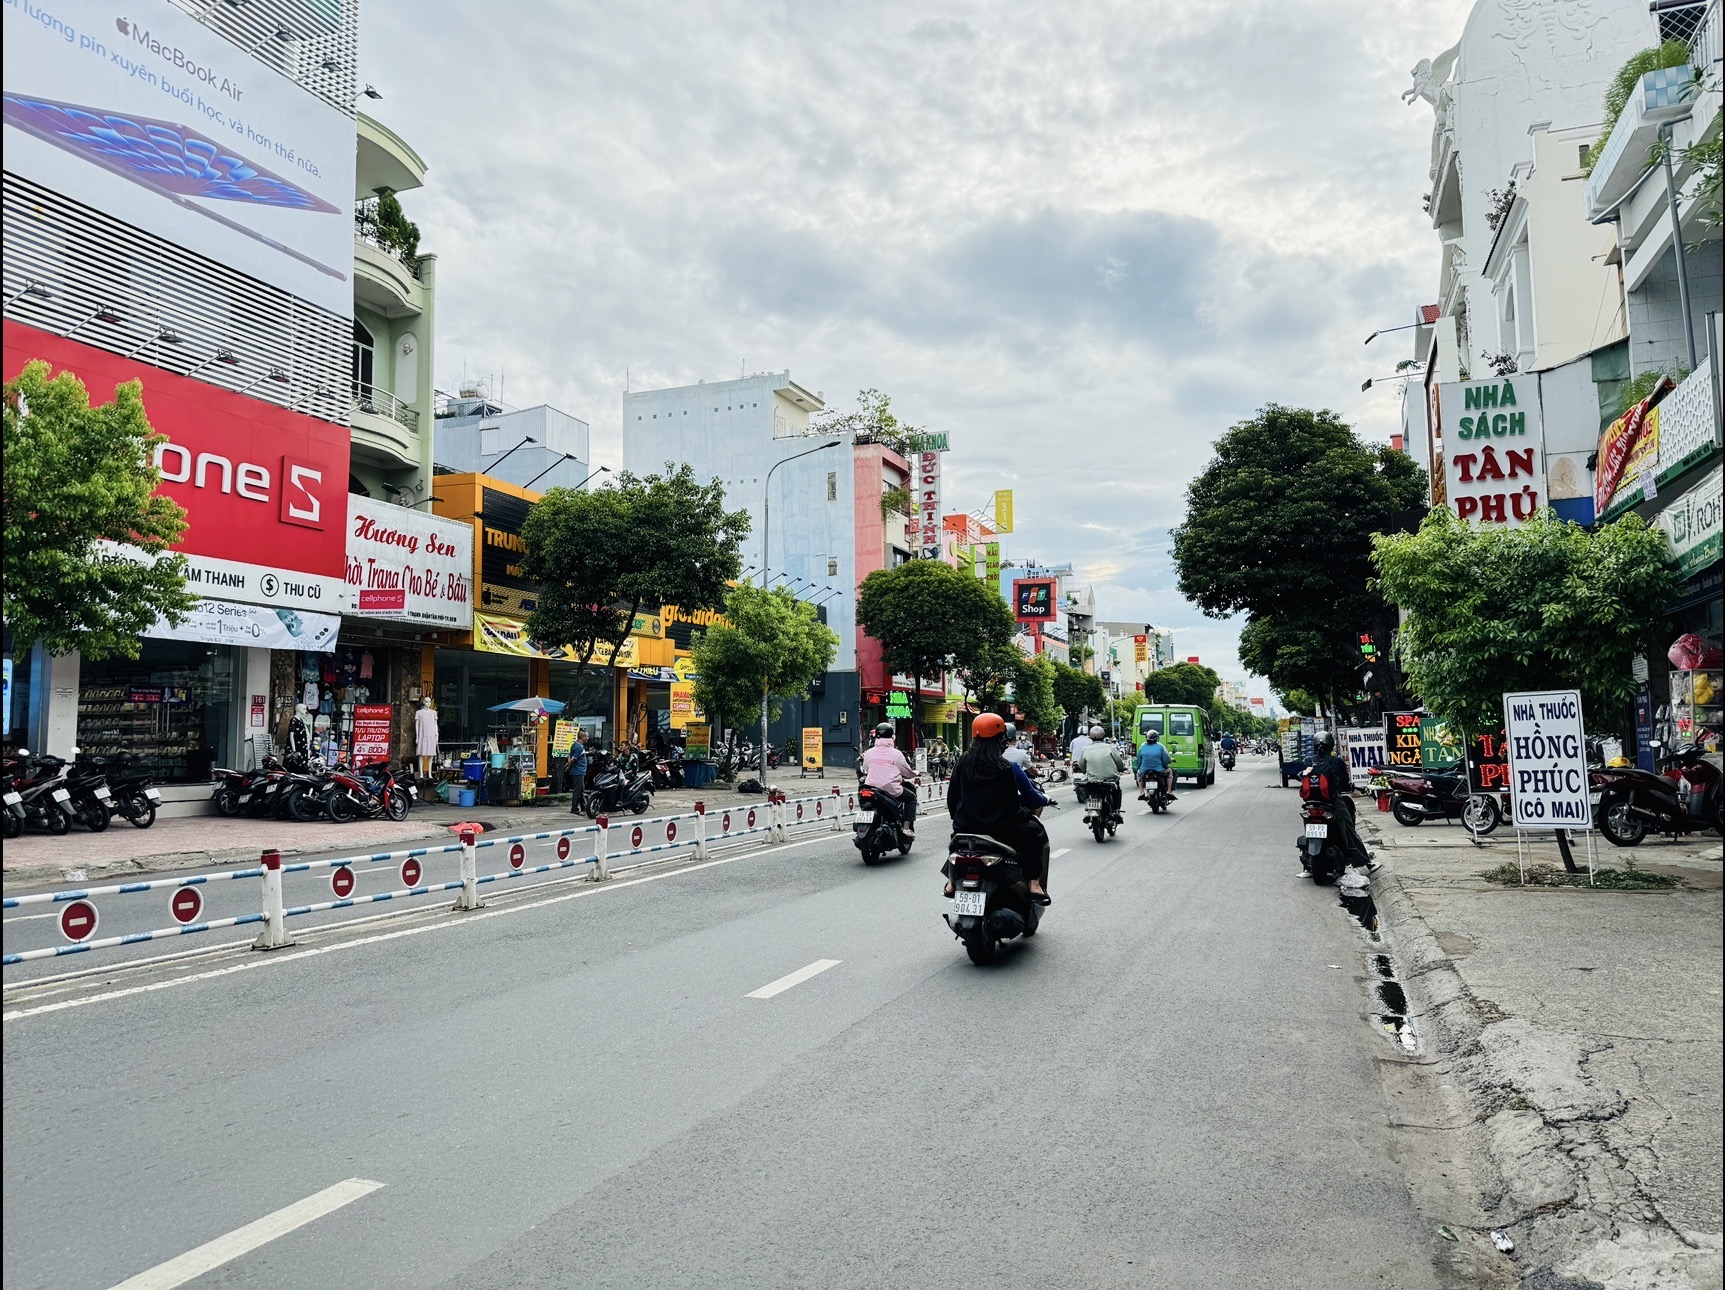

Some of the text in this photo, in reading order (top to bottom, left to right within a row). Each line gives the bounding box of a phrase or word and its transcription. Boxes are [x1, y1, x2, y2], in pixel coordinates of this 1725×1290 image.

[132, 24, 243, 102] MacBook Air
[80, 33, 106, 57] pin
[110, 51, 157, 86] xuyên
[161, 77, 194, 105] buổi
[197, 97, 226, 126] học,
[229, 117, 244, 134] và
[248, 126, 272, 151] hơn
[275, 141, 294, 163] thế
[297, 158, 321, 178] nữa.
[1464, 379, 1517, 410] NHÀ
[1458, 411, 1525, 440] SÁCH
[1453, 445, 1534, 483] TÂN
[922, 452, 936, 544] ĐỨC THỊNH
[1455, 485, 1538, 523] PHÚ
[354, 514, 457, 558] Hương Sen
[205, 570, 245, 588] THANH
[283, 582, 304, 597] THU
[307, 583, 321, 599] CŨ
[367, 557, 399, 589] Trang
[401, 564, 422, 600] Cho
[424, 567, 439, 599] Bé
[447, 571, 468, 603] Bầu
[217, 603, 247, 618] Series
[361, 595, 397, 603] cellphone
[1022, 604, 1045, 614] Shop
[1396, 715, 1421, 727] SPA
[1513, 696, 1576, 721] NHÀ THUỐC
[358, 734, 386, 742] LAPTOP
[1349, 730, 1384, 743] NHÀ THUỐC
[1514, 722, 1579, 760] HỒNG
[1350, 745, 1384, 768] MAI
[1390, 749, 1422, 765] NGÂ
[1518, 762, 1581, 794] PHÚC
[1519, 797, 1585, 821] (CÔ MAI)
[955, 903, 982, 914] 904.31
[959, 893, 980, 903] 59-D1
